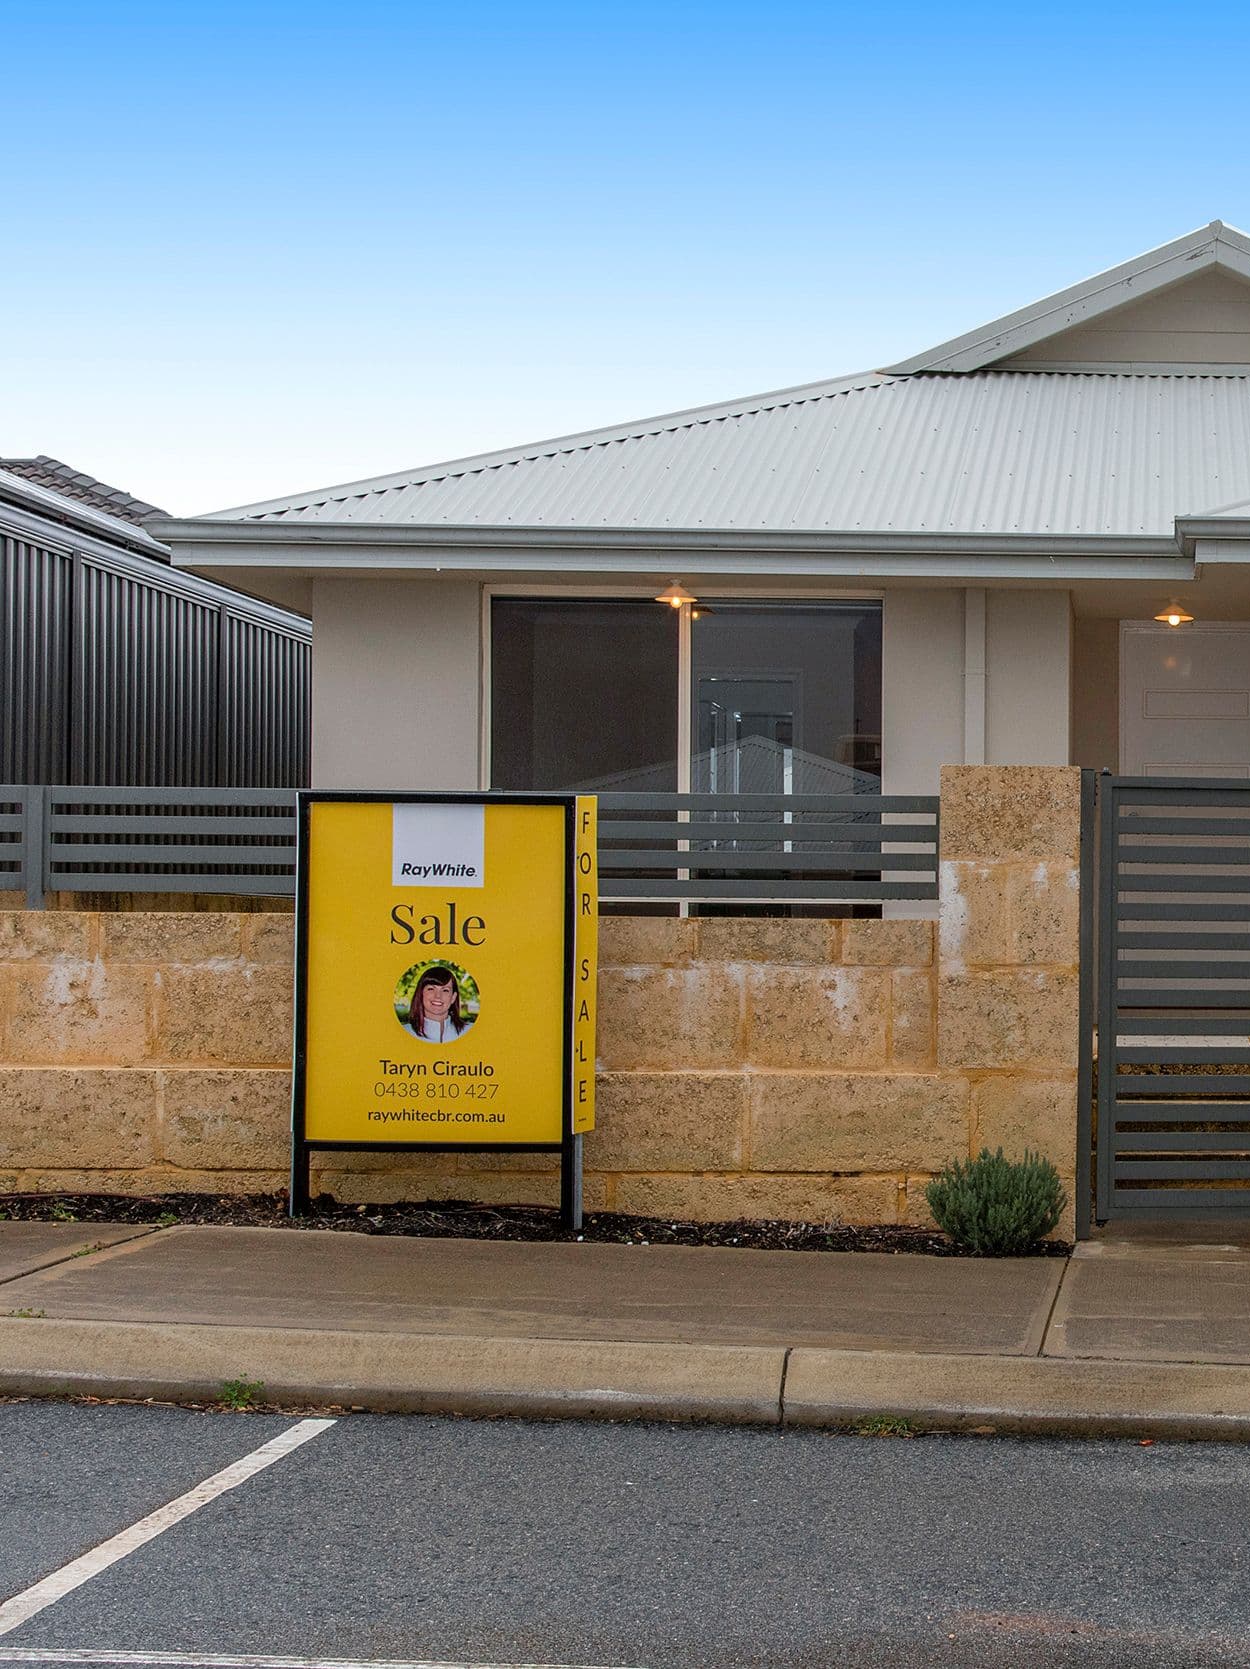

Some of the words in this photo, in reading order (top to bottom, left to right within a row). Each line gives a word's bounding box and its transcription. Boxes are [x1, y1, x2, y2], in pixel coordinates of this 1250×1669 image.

[579, 811, 592, 916] FOR
[390, 902, 487, 946] Sale
[578, 958, 590, 1103] SALE
[379, 1059, 427, 1078] Taryn
[432, 1060, 495, 1077] Ciraulo
[374, 1081, 420, 1098] 0438
[425, 1082, 460, 1099] 810
[464, 1083, 500, 1099] 427
[367, 1108, 506, 1123] raywhitecbr.com.au
